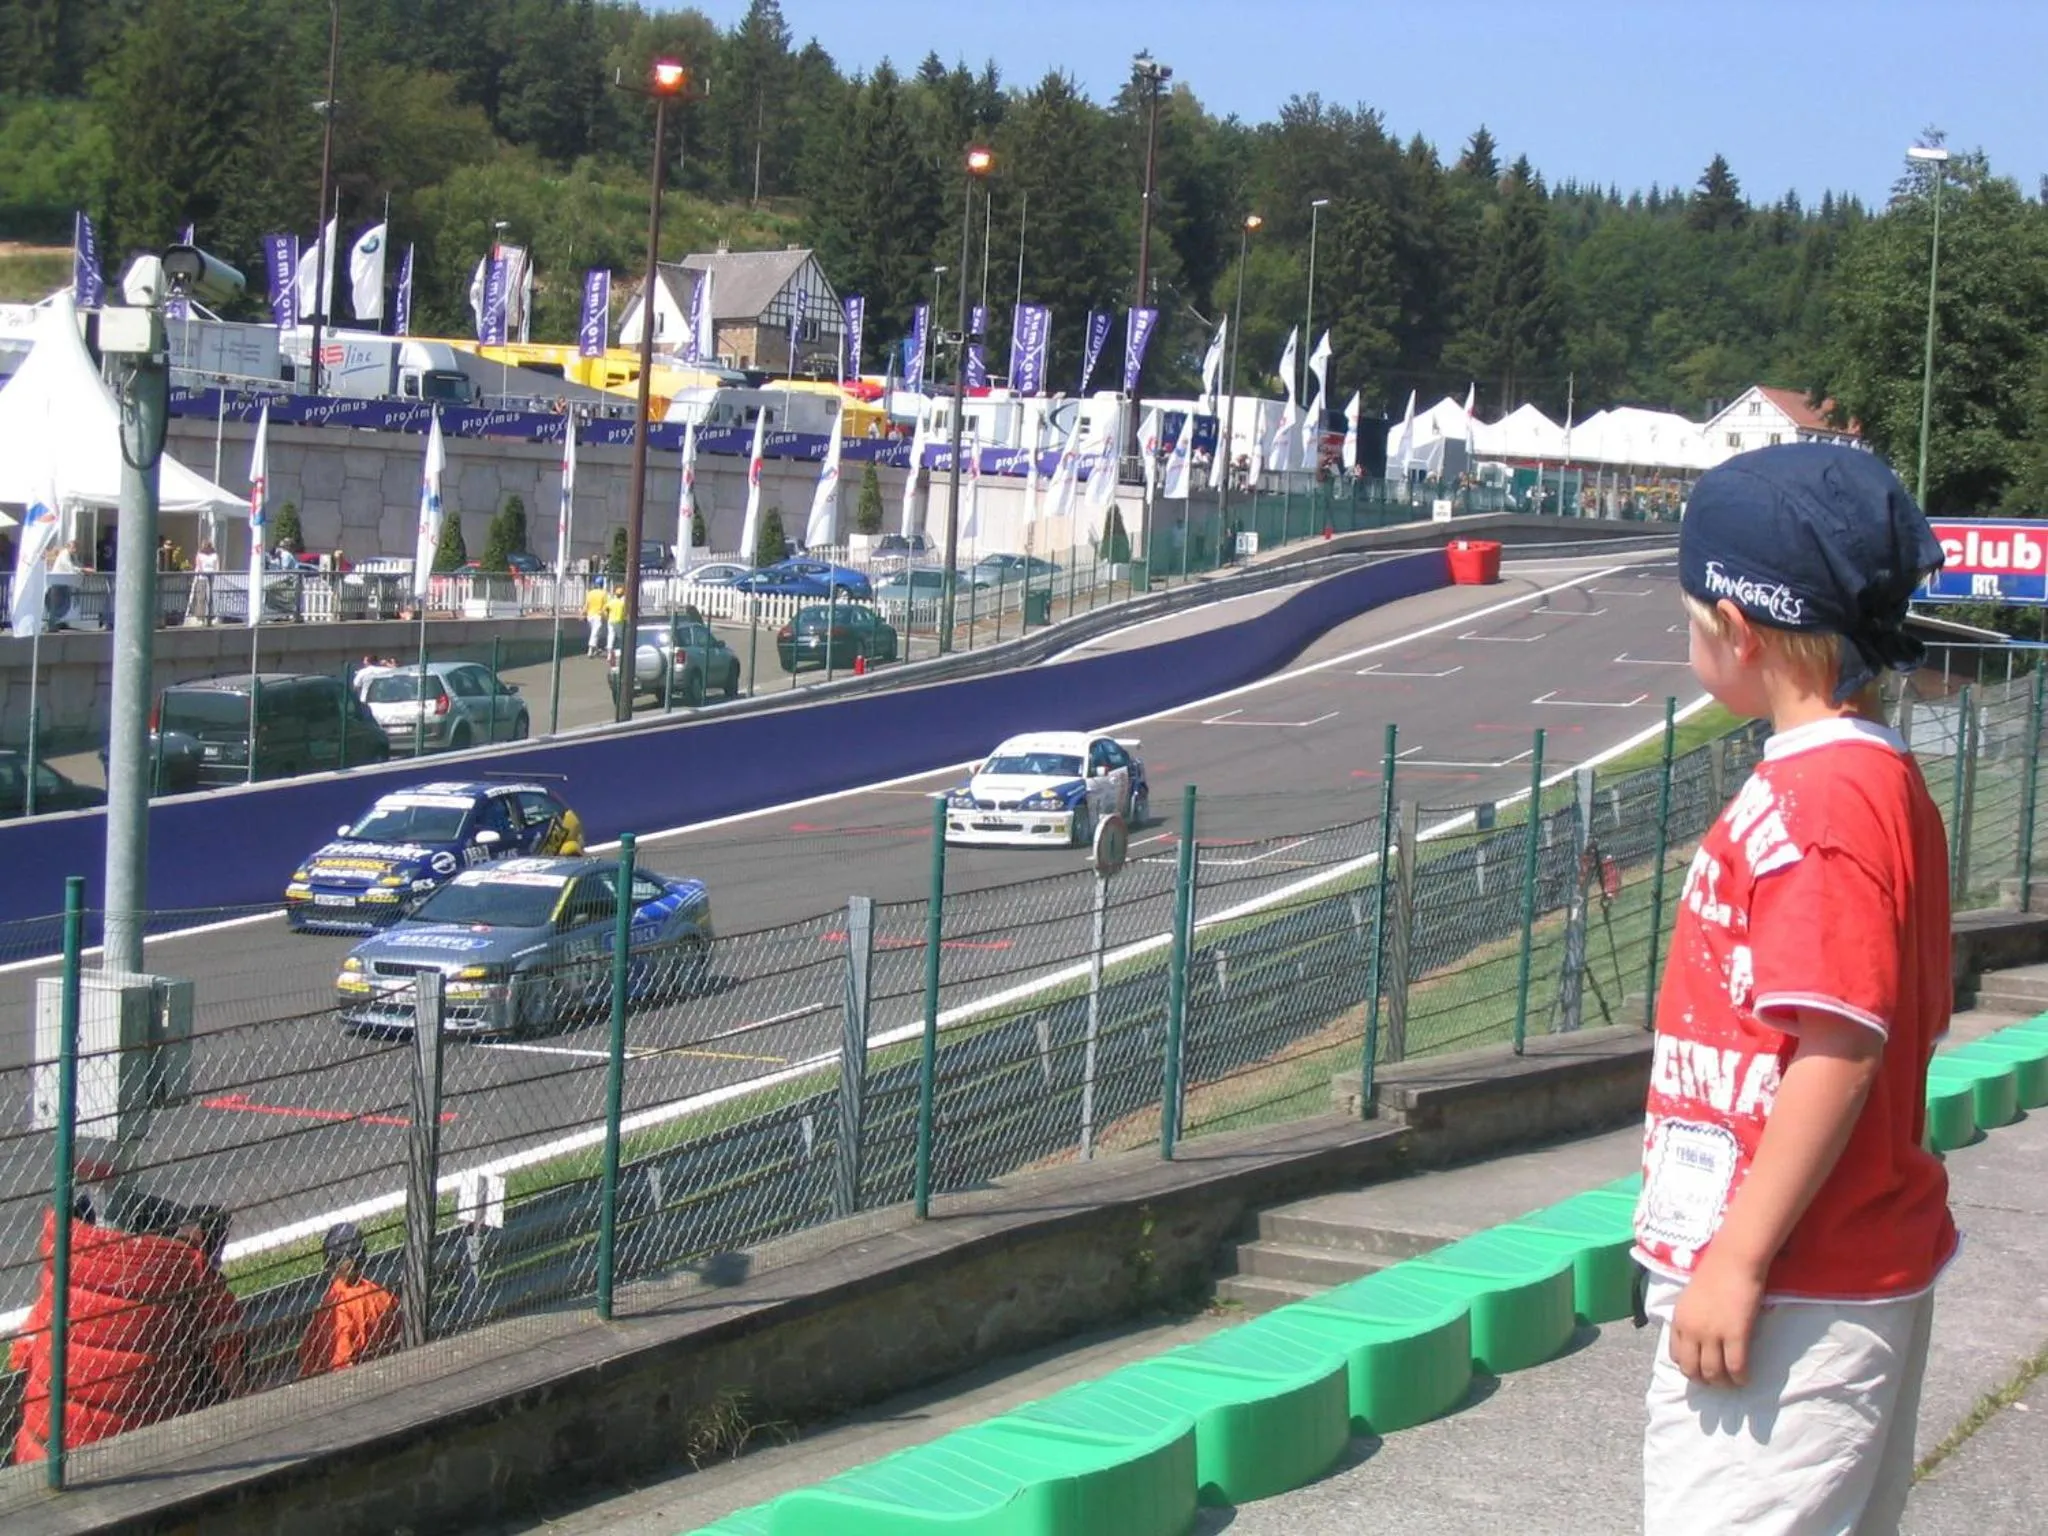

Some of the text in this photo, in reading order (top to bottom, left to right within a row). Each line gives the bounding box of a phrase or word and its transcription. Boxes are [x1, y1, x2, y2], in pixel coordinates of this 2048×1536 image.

[305, 399, 368, 423] proximus
[462, 408, 520, 434] proximus
[1940, 531, 2042, 570] club
